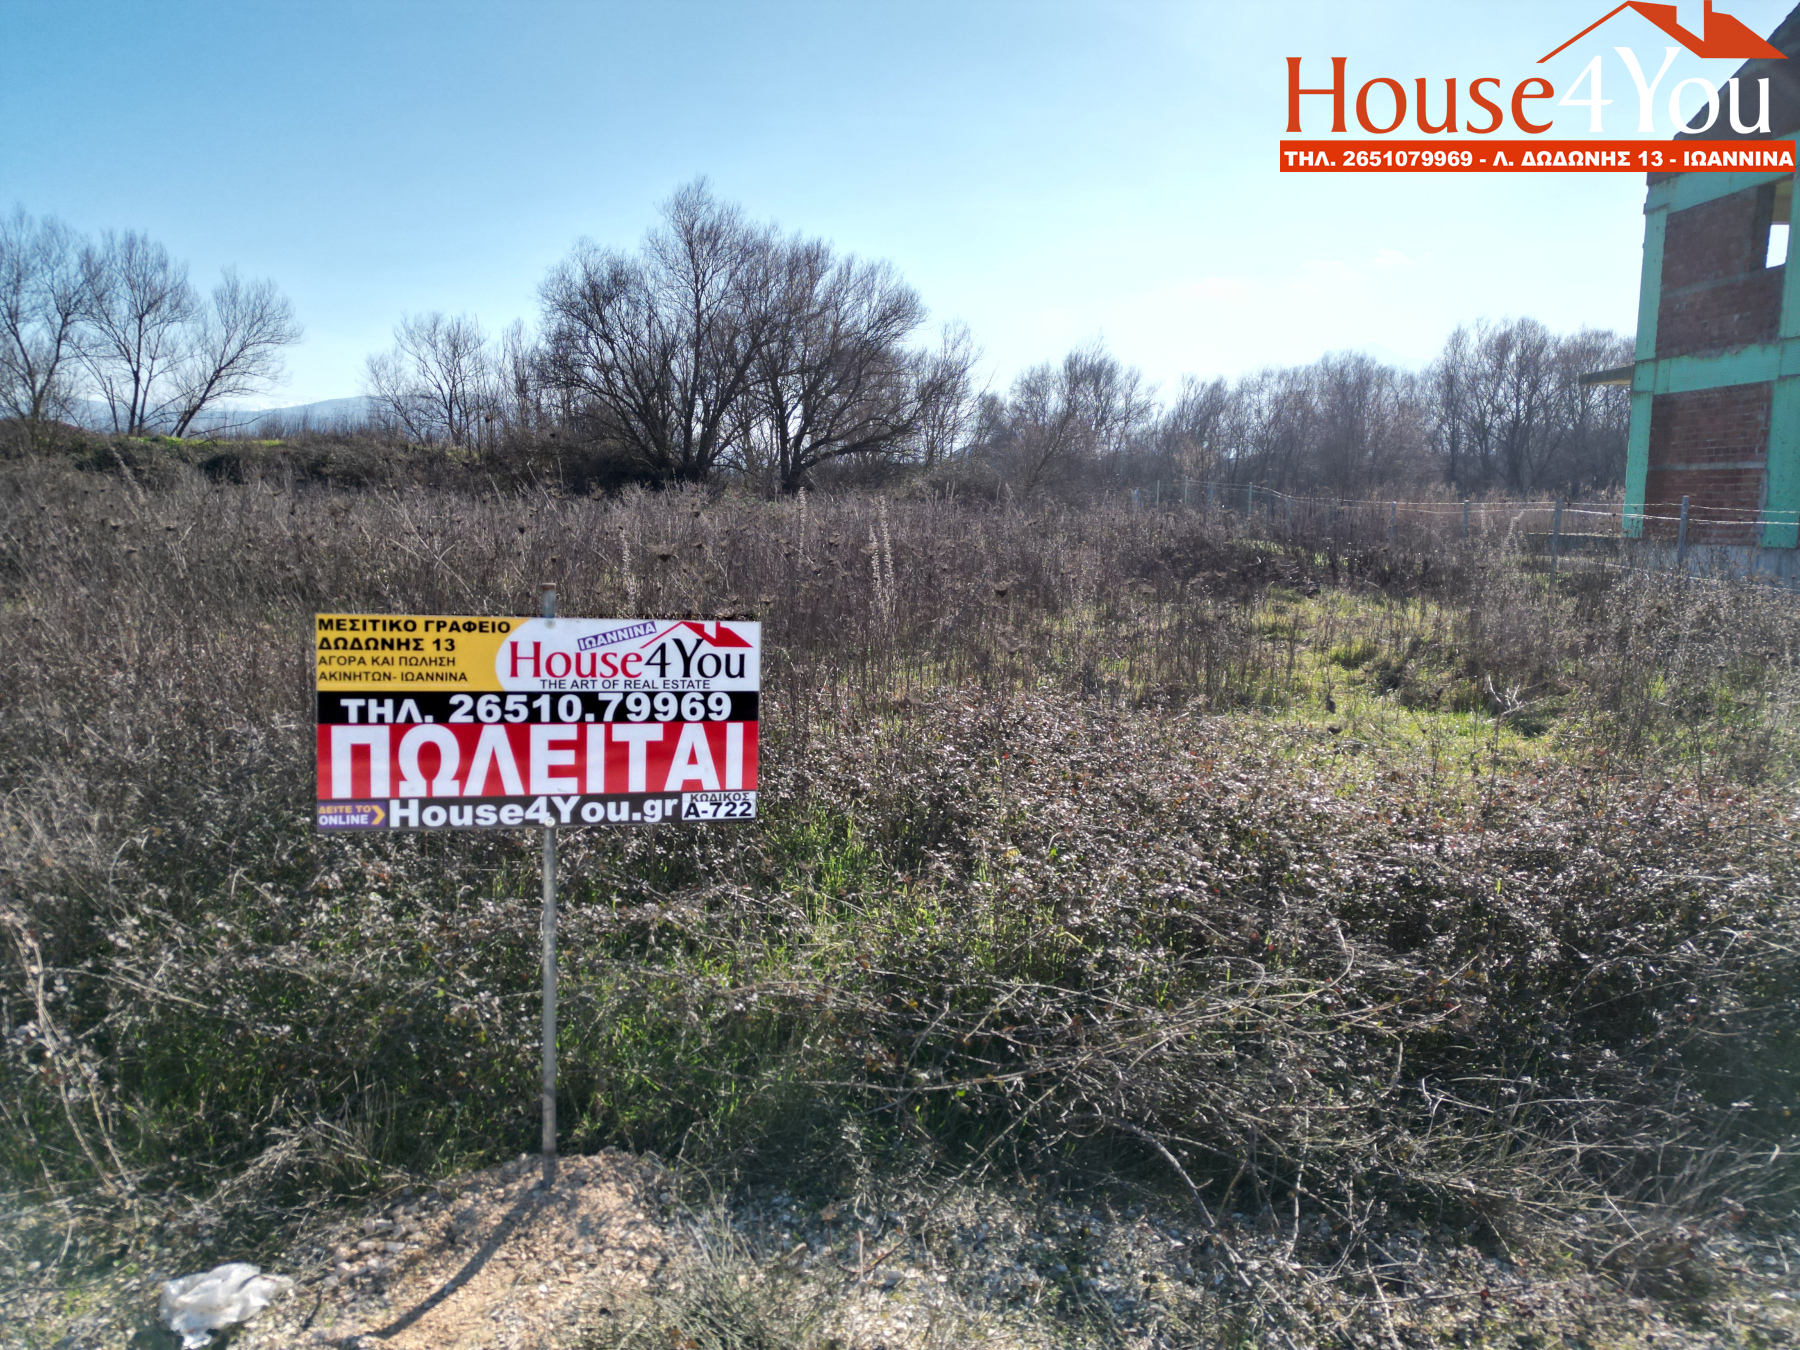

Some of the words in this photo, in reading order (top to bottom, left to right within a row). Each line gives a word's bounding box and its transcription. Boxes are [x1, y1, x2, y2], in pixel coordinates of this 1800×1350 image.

[318, 618, 418, 632] ΜΕΣΙΤΙΚΟ
[424, 619, 511, 634] ΓΡΑΦΕΙΟ
[578, 622, 656, 651] ΙΩΑΝΝΙΝΑ
[318, 637, 424, 651] ΔΩΔΩΝΗΣ
[432, 639, 455, 651] 13
[318, 656, 367, 666] ΑΓΟΡΑ
[372, 656, 394, 666] ΚΑΙ
[398, 656, 456, 667] ΠΩΛΗΣΗ
[510, 639, 746, 679] House4You
[318, 672, 397, 682] ΑΚΙΝΗΤΩΝ-
[401, 672, 468, 682] ΙΩΑΝΝΙΝΑ
[540, 679, 566, 690] THE
[570, 679, 598, 690] ART
[602, 679, 620, 690] OF
[624, 679, 659, 690] REAL
[663, 679, 711, 690] ESTATE
[340, 698, 434, 723] ΤΗΛ.
[448, 692, 732, 722] 26510.79969
[331, 722, 744, 799] ΠΩΛΕΙΤΑΙ
[690, 792, 750, 802] ΚΩΔΙΚΟΣ
[318, 805, 351, 814] ΔΕΙΤΕ
[355, 805, 371, 814] ΤΟ
[389, 796, 678, 827] House4You.gr
[318, 814, 369, 826] ONLINE
